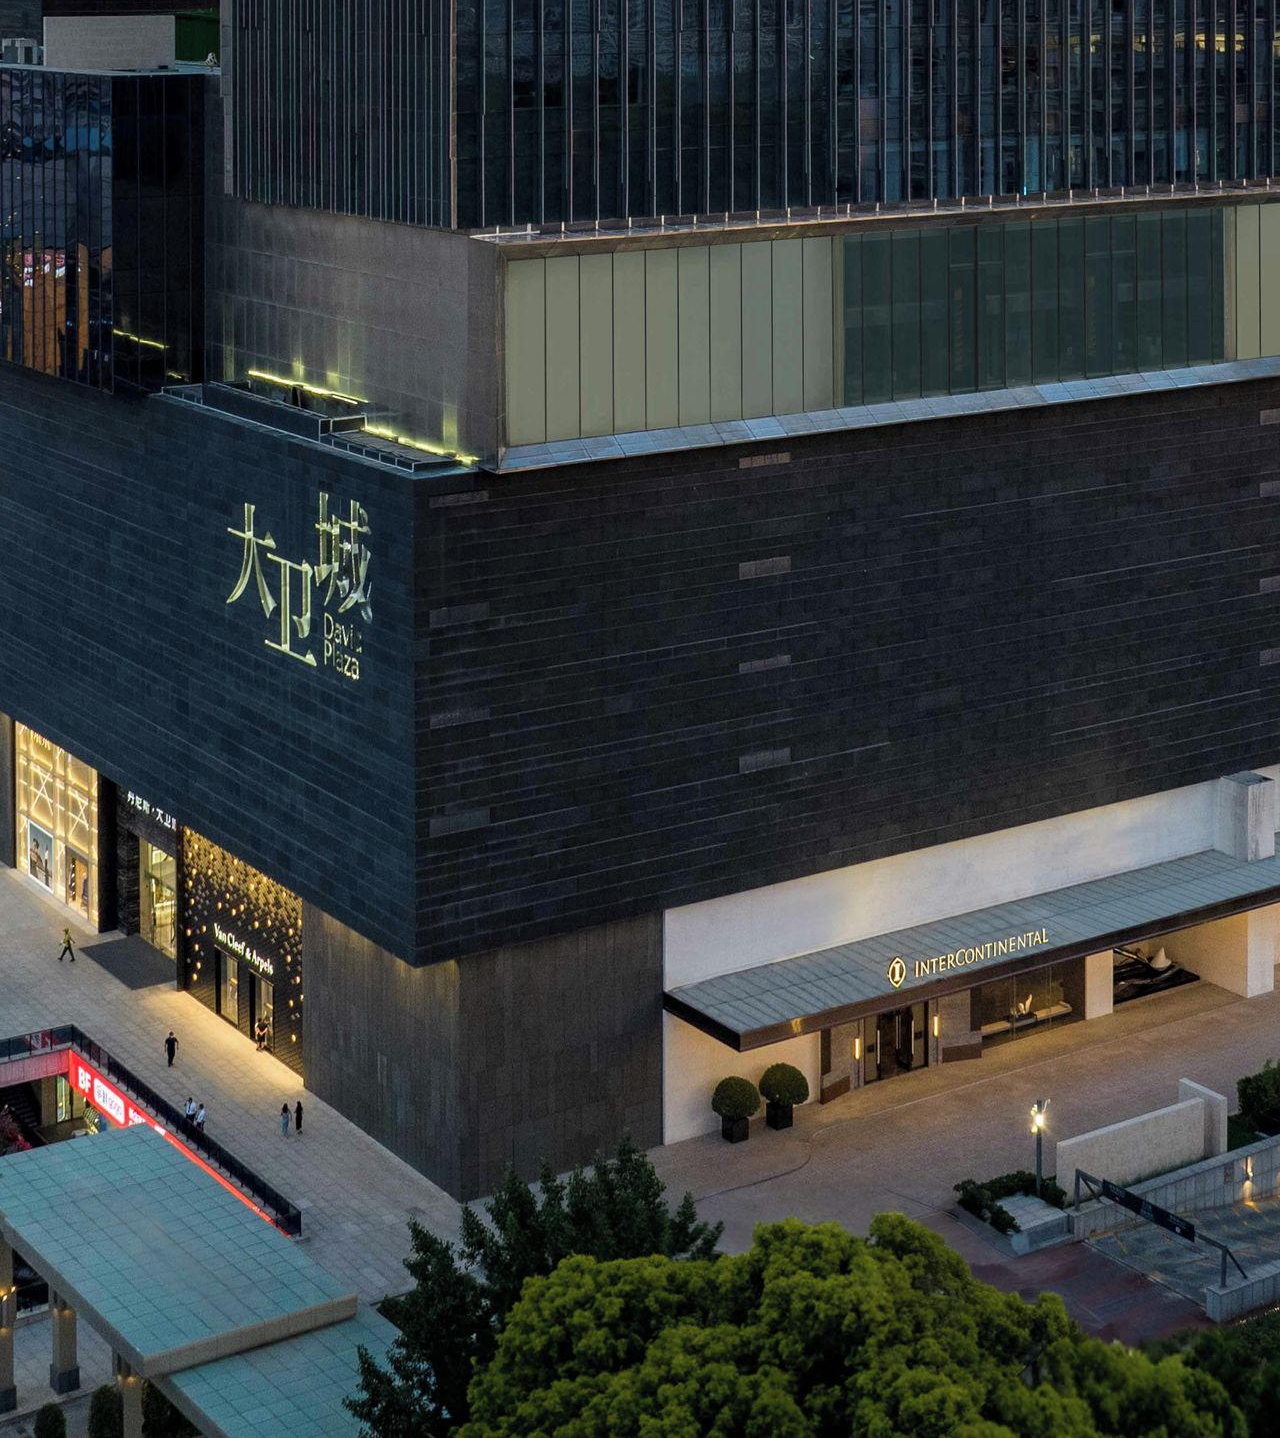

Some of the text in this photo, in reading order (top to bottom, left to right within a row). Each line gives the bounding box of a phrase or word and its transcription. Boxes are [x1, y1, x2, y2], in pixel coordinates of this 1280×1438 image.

[226, 492, 374, 667] 大卫城
[324, 641, 360, 681] Plaza
[214, 922, 274, 975] Van Cleef & Arpels
[914, 928, 1049, 978] INTERCONTINENTAL
[78, 1066, 91, 1093] BF
